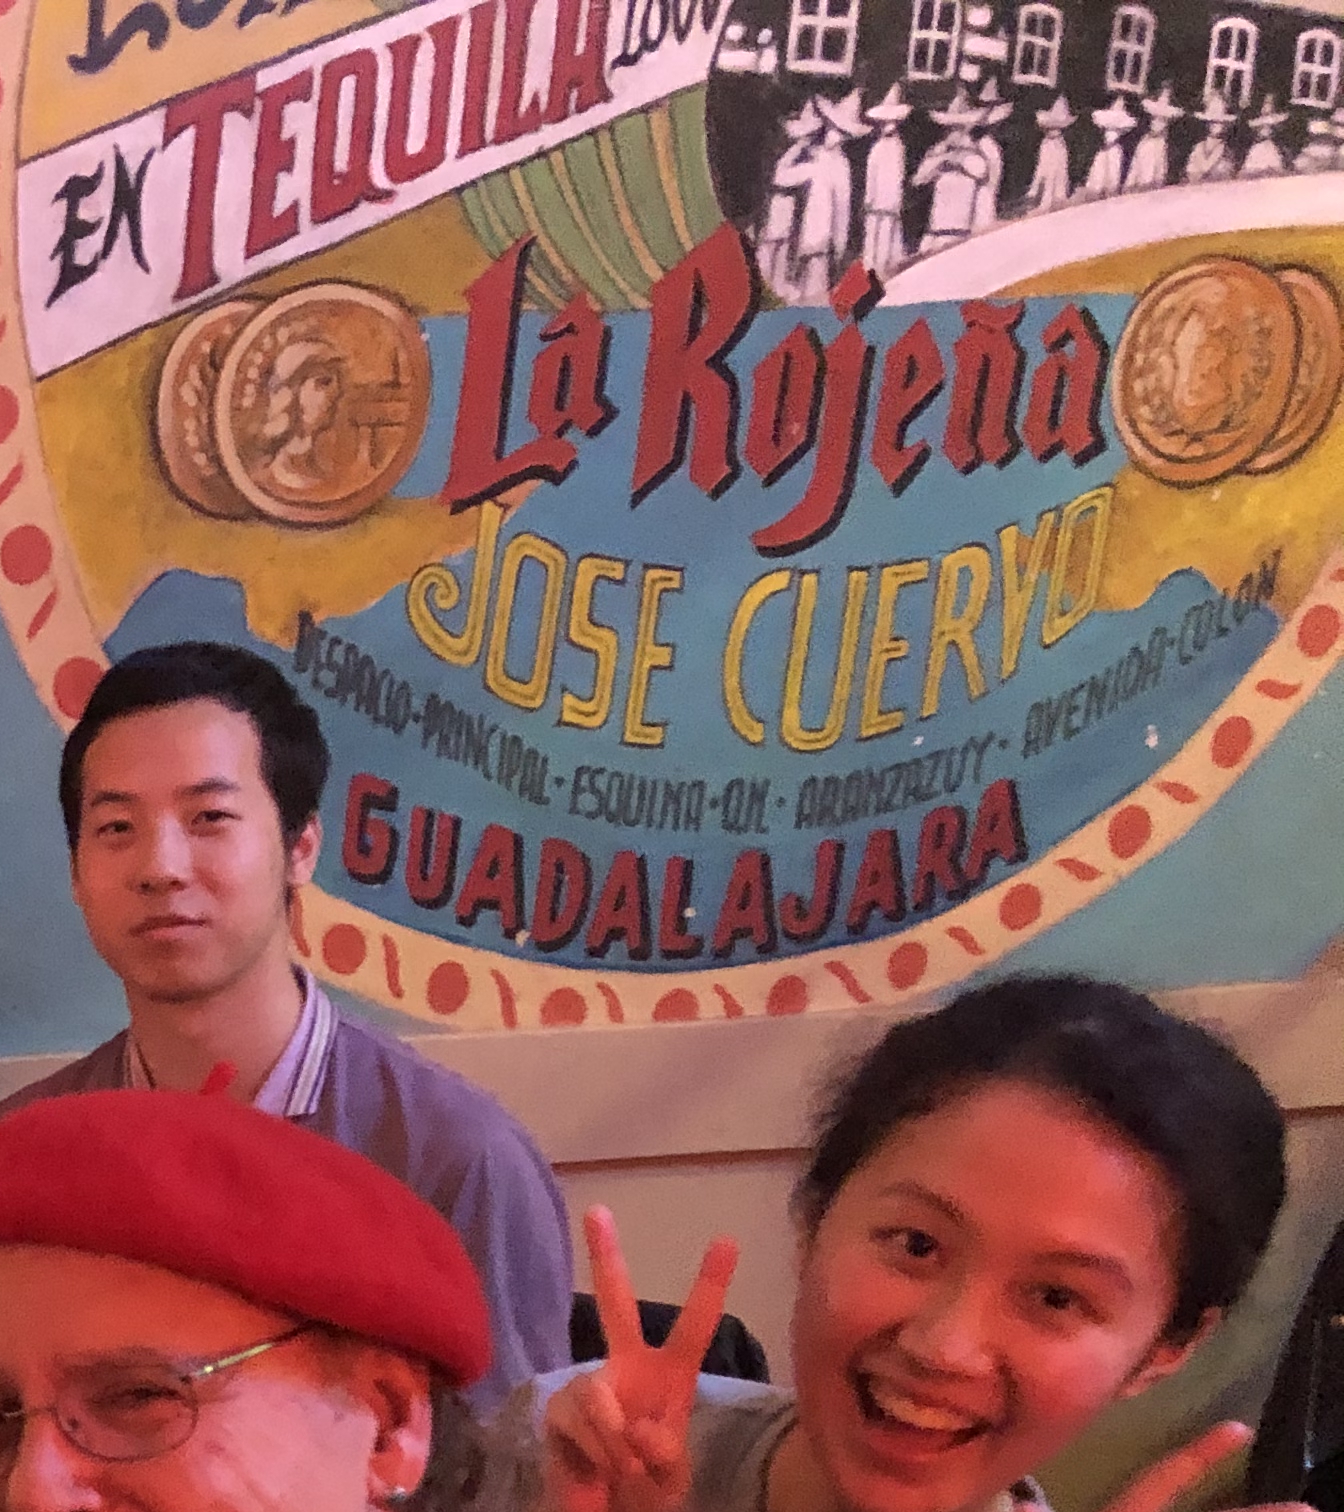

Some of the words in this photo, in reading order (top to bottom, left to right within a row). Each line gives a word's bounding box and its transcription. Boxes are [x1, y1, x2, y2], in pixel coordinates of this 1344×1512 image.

[44, 144, 155, 309] EN
[162, 0, 612, 301] TEQUILA
[440, 232, 618, 516] La
[630, 224, 1110, 556] Rojeña
[405, 500, 683, 747] JOSE
[722, 484, 1113, 751] CUERVO
[342, 773, 1028, 960] GUADALAJARA
